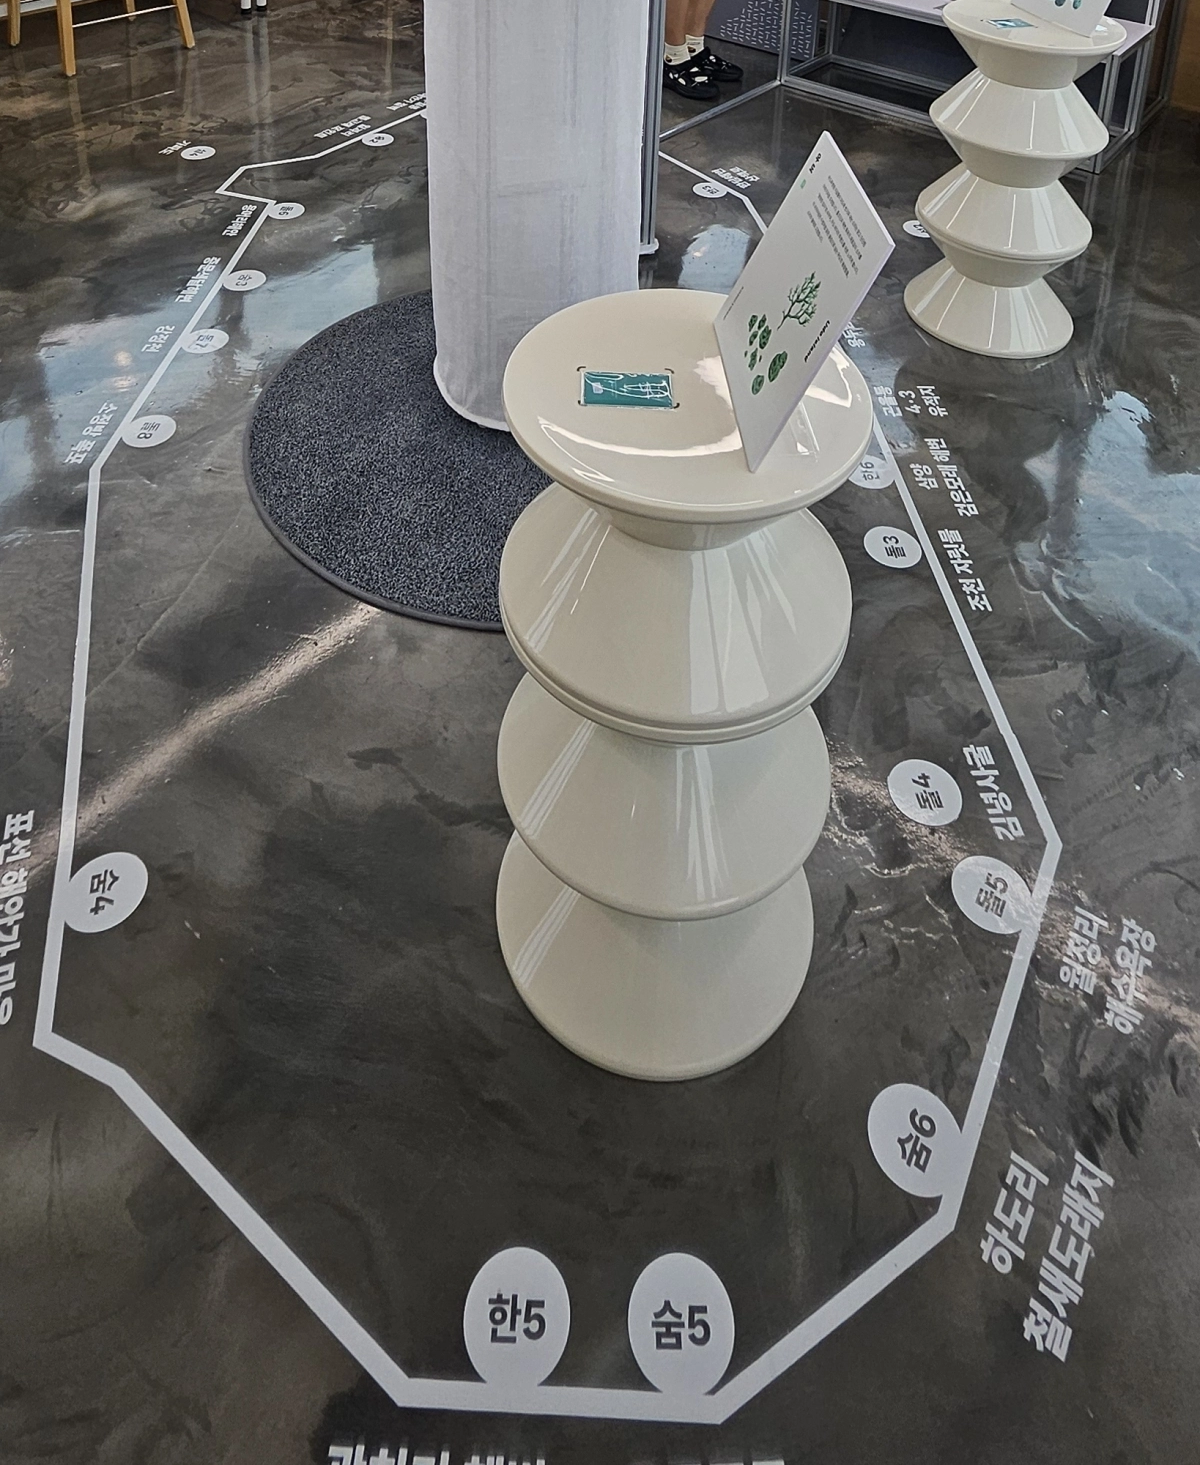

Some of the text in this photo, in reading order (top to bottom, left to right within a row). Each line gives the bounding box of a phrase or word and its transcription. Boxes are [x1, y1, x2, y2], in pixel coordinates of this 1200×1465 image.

[221, 204, 258, 237] 용머리해안
[174, 256, 221, 303] 중문색달해변
[141, 325, 175, 353] 강정천
[873, 386, 903, 417] 곤을동
[898, 390, 921, 414] 4·3
[916, 385, 948, 417] 유적지
[64, 400, 118, 464] 소정방 폭포
[860, 461, 880, 481] 한6
[909, 463, 938, 490] 삼양
[924, 438, 979, 517] 검은모래 해변
[883, 535, 907, 559] 돌3
[938, 528, 992, 612] 조천 자릿물
[911, 772, 944, 811] 돌4
[962, 744, 1025, 841] 김녕사굴
[90, 869, 119, 916] 숨4
[974, 872, 1009, 918] 돌5
[1059, 906, 1109, 995] 월정리
[1104, 918, 1157, 1035] 해수욕장
[897, 1108, 936, 1173] 숨6
[980, 1150, 1049, 1274] 하도리
[1022, 1150, 1115, 1363] 철새도래지
[488, 1293, 546, 1343] 한5
[651, 1300, 710, 1350] 숨5
